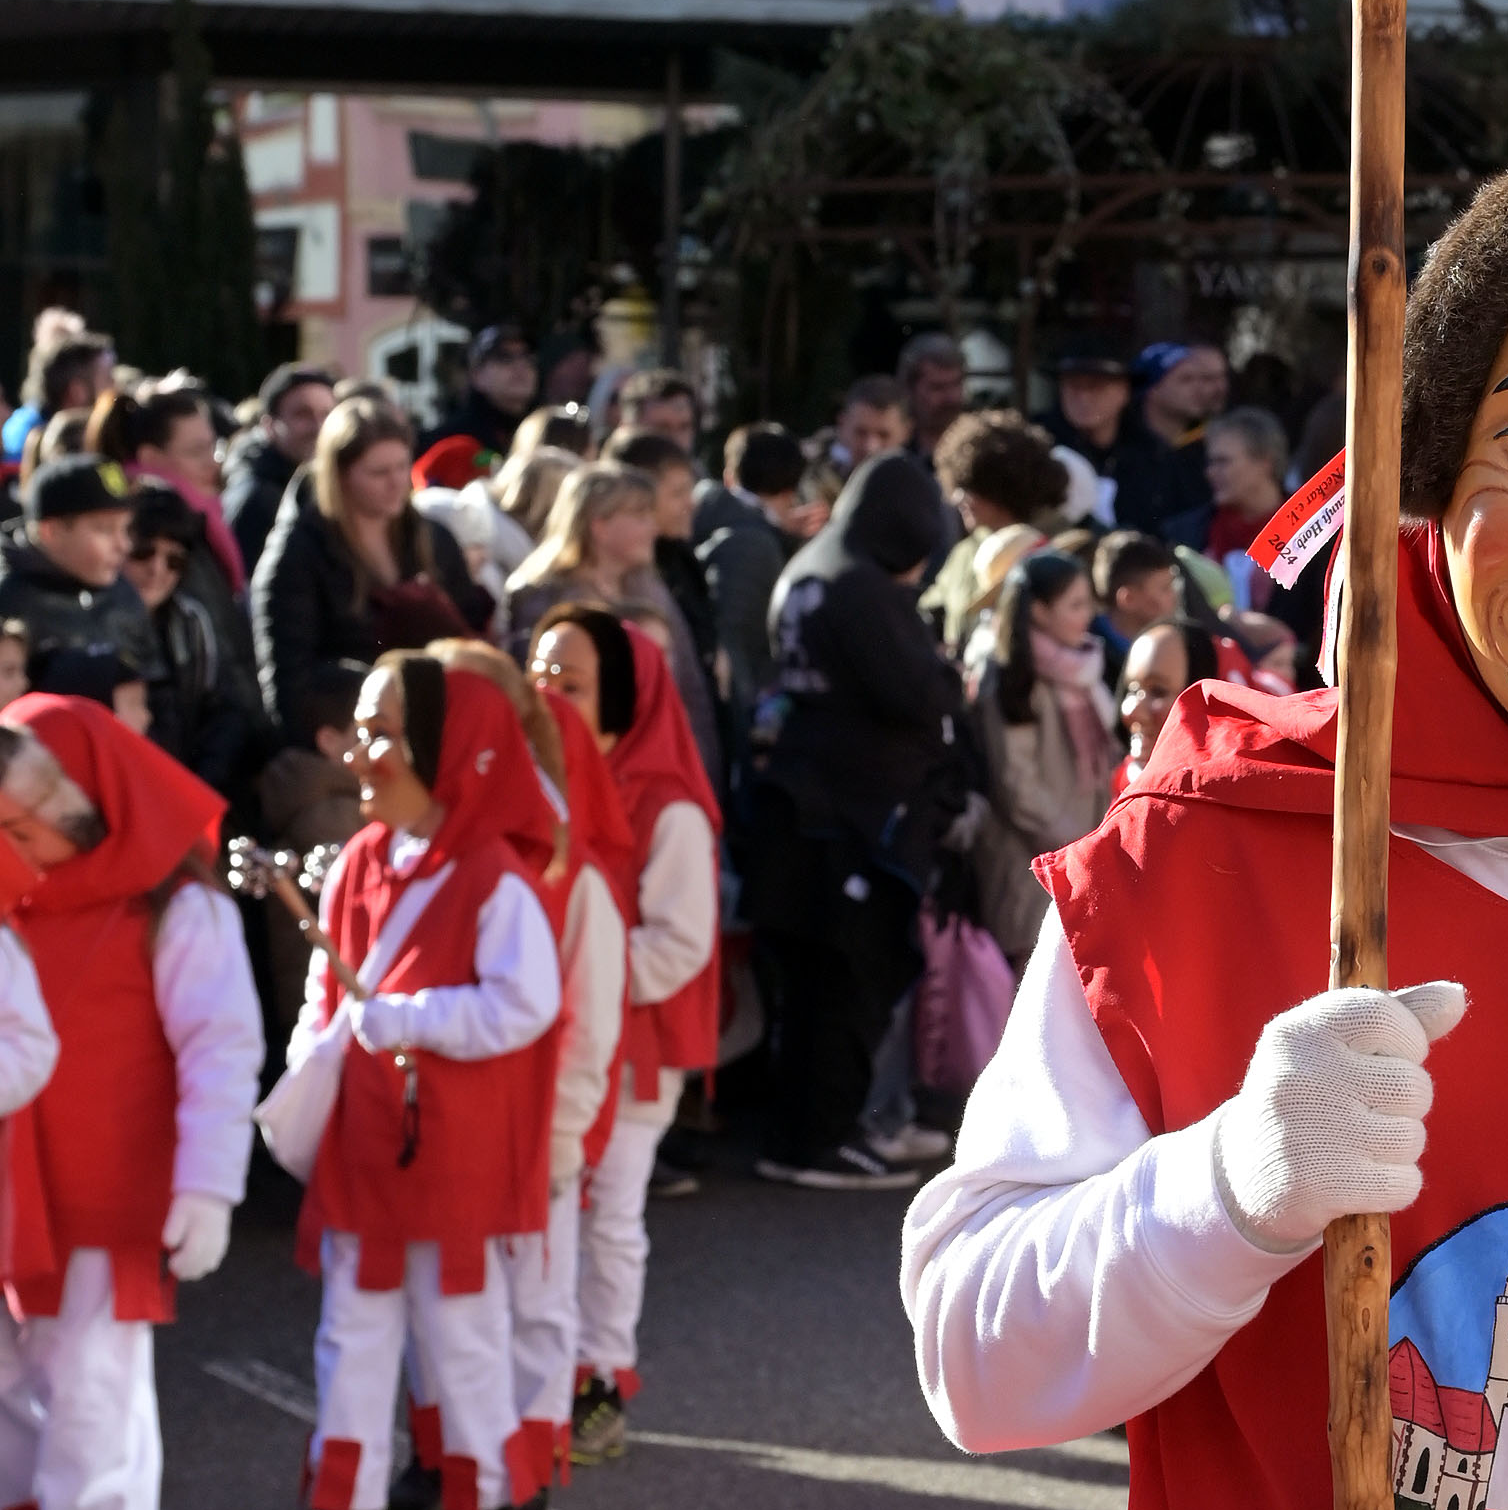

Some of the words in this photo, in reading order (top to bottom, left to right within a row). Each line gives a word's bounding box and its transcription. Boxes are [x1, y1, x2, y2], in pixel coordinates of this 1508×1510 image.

[1306, 467, 1344, 505] Neckar
[1268, 533, 1298, 566] 2024
[1296, 518, 1324, 550] Horb
